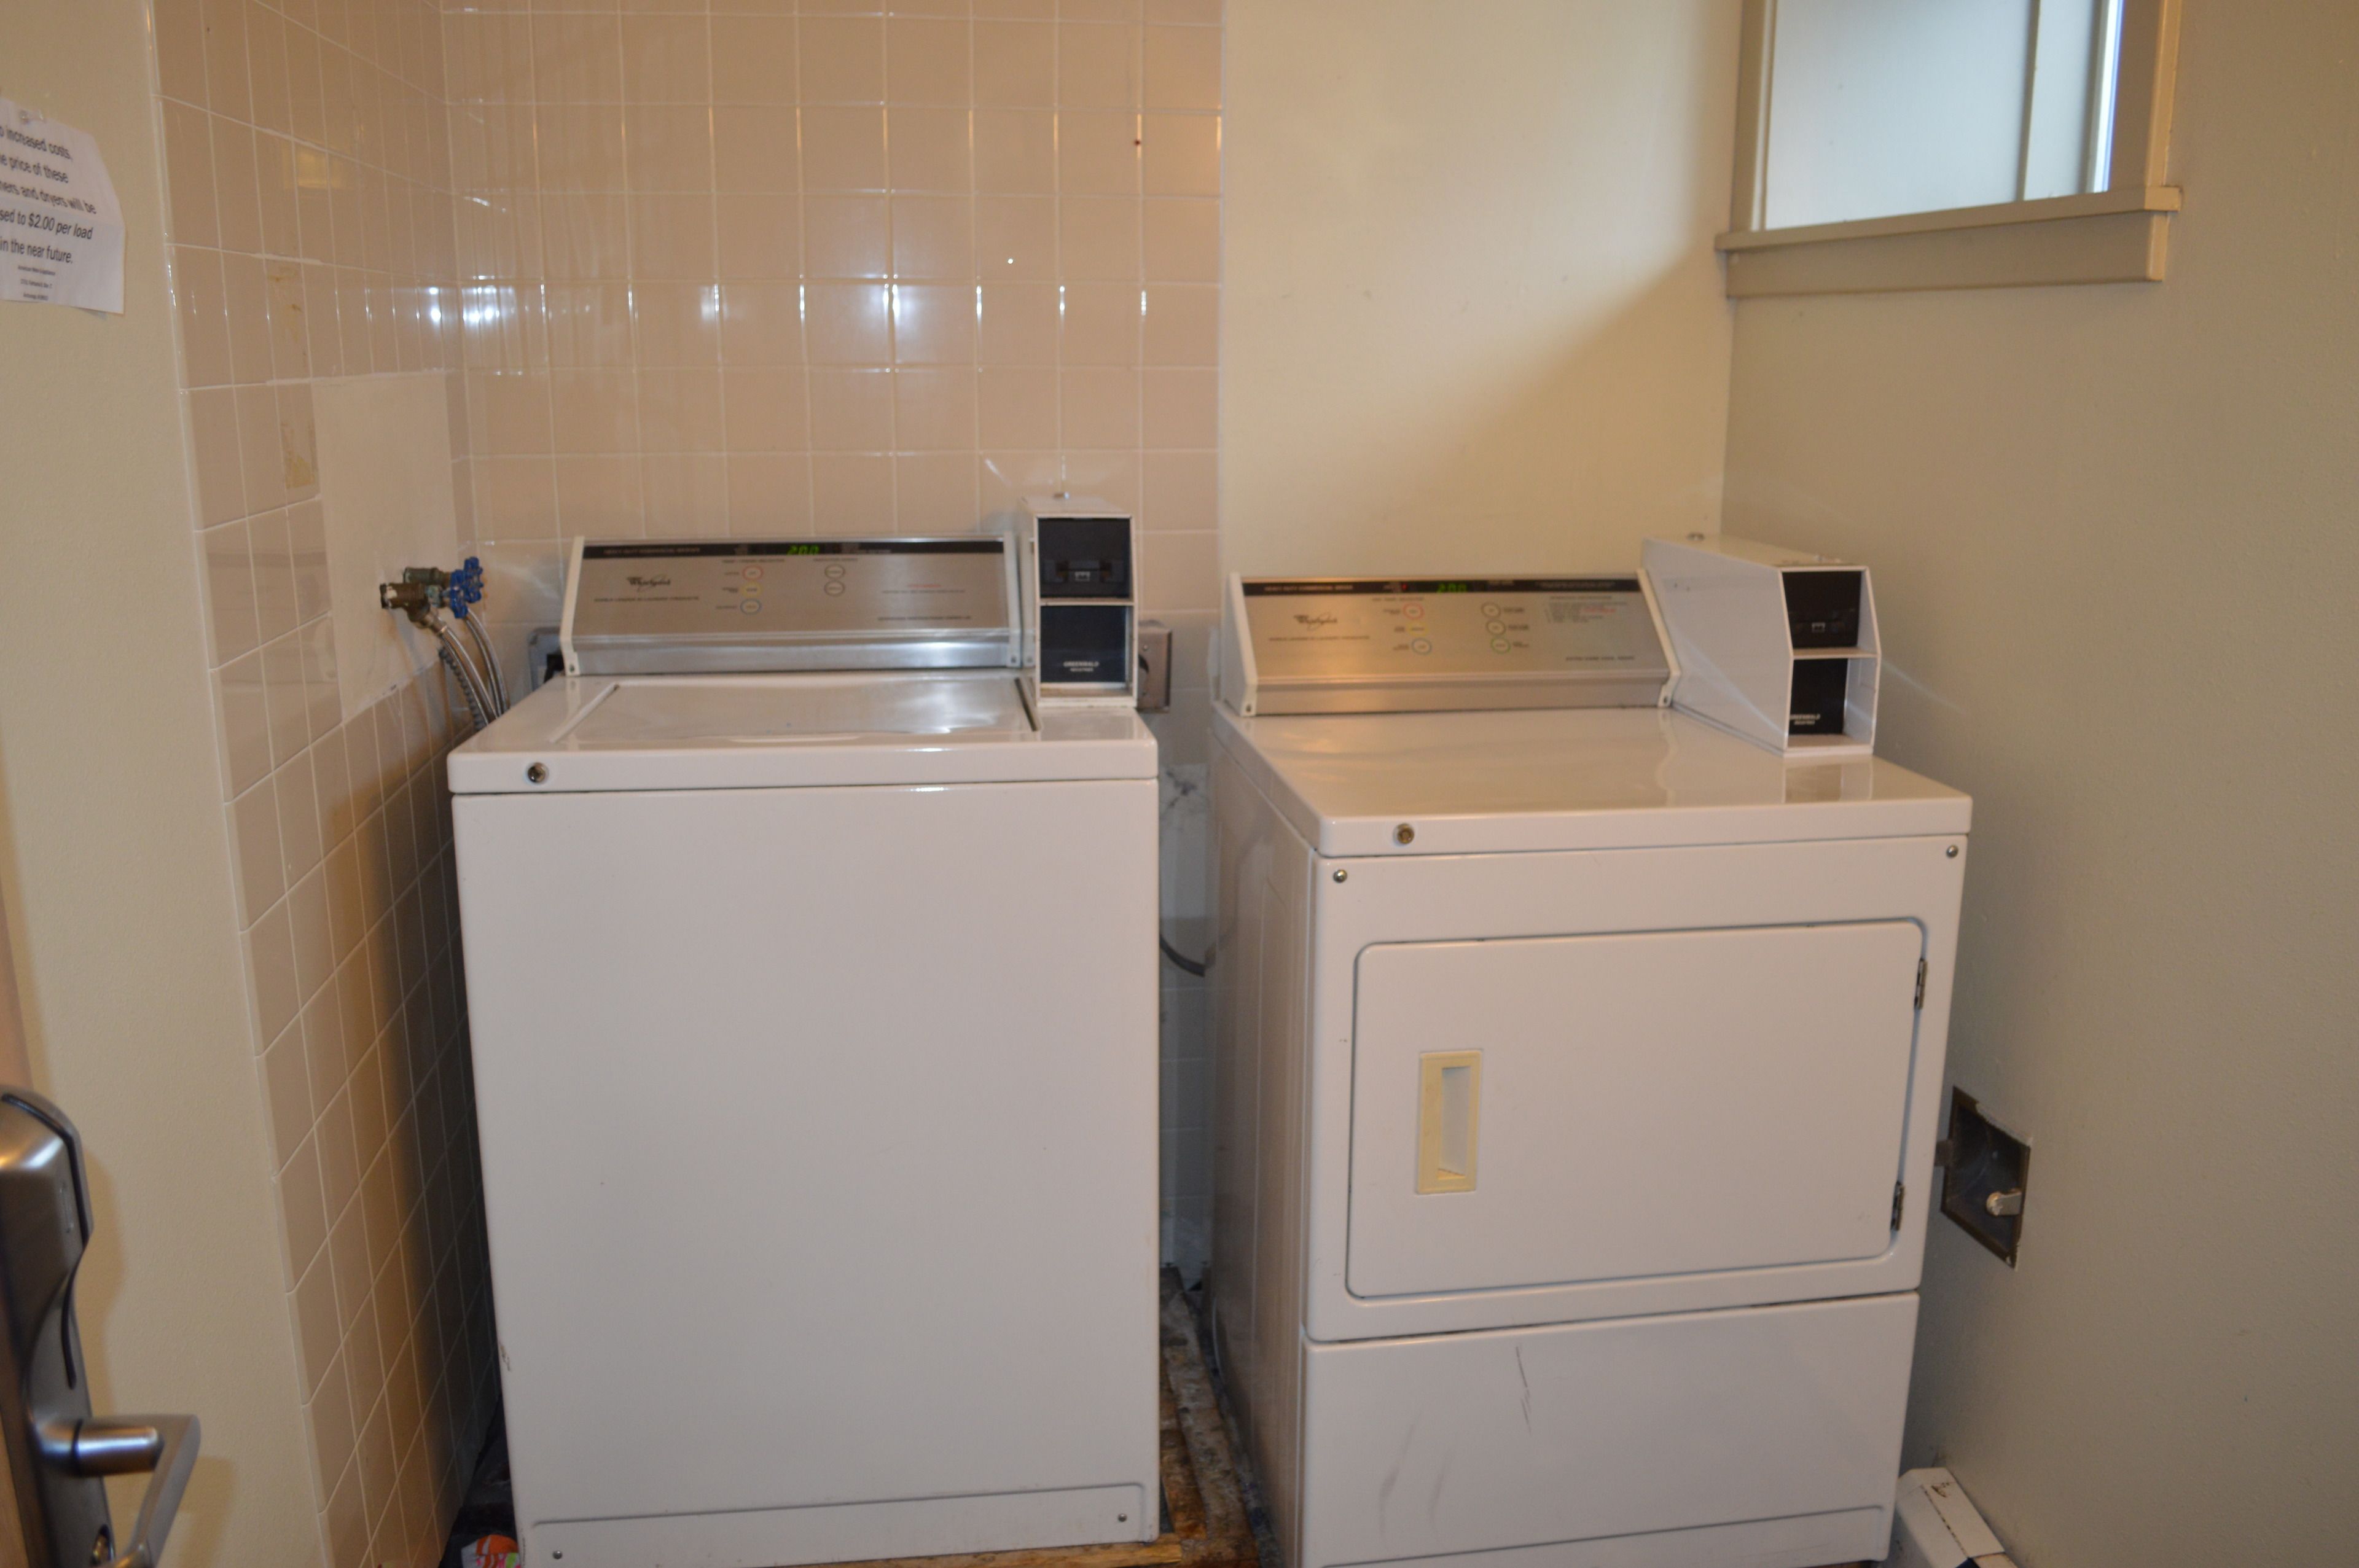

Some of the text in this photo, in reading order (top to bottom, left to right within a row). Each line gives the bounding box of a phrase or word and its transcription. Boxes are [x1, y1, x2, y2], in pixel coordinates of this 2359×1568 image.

[6, 126, 47, 152] increased
[9, 156, 31, 173] price
[33, 163, 42, 176] of
[43, 165, 69, 183] these
[20, 186, 39, 200] and
[17, 211, 26, 225] to
[28, 213, 55, 231] $2.00
[55, 222, 72, 235] per
[73, 224, 94, 240] load
[10, 239, 25, 254] the
[27, 244, 45, 257] near
